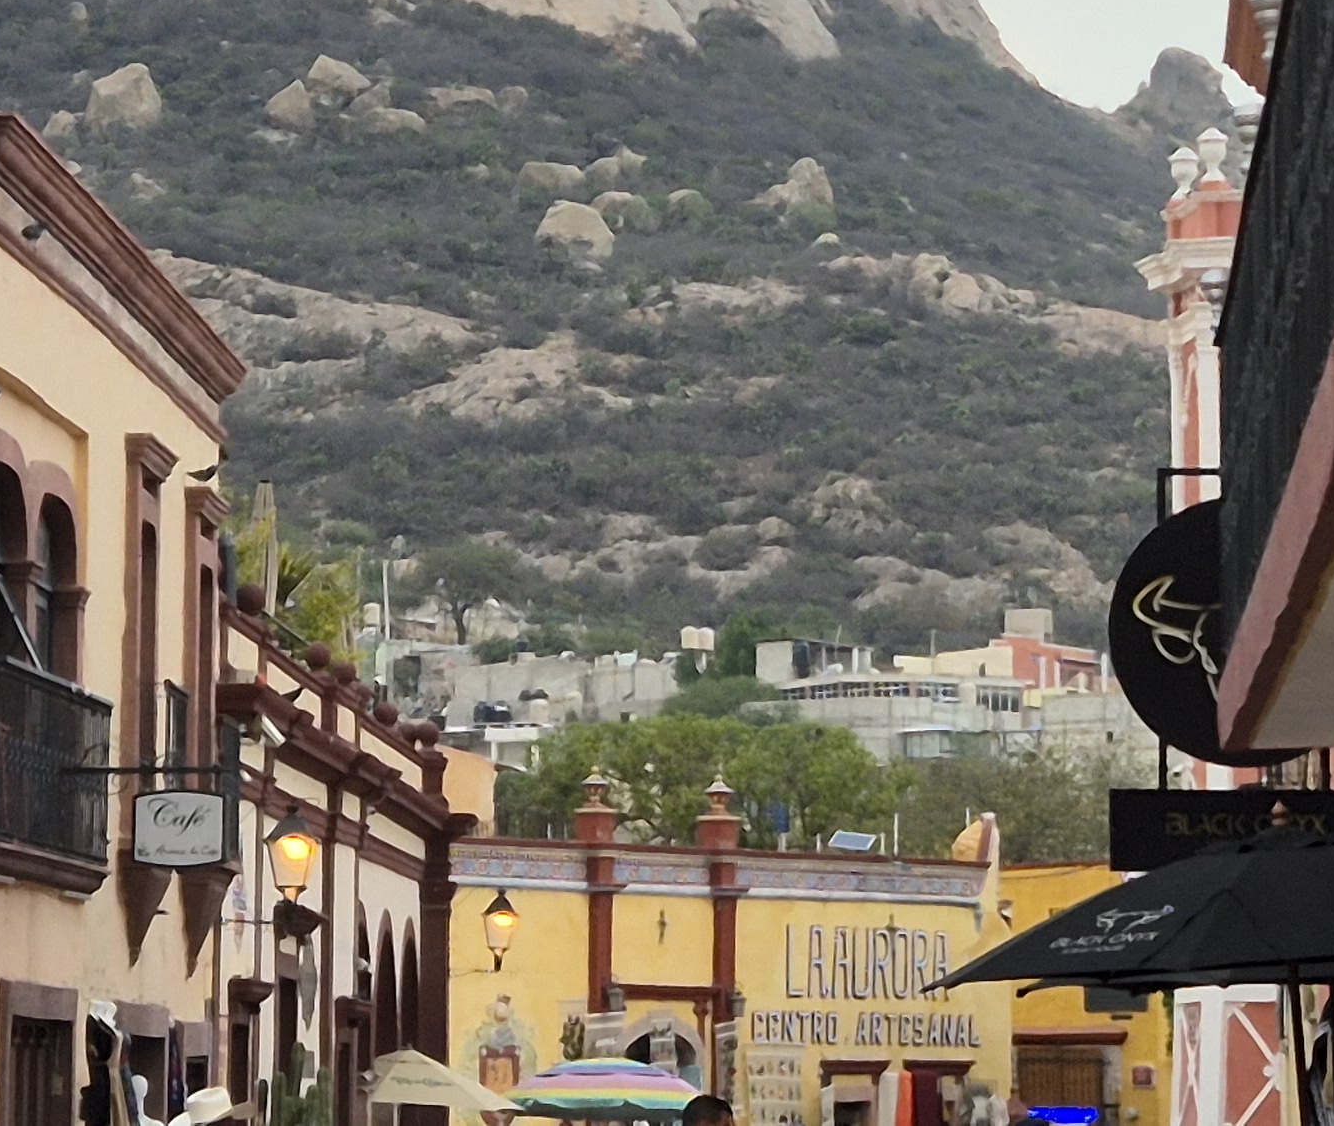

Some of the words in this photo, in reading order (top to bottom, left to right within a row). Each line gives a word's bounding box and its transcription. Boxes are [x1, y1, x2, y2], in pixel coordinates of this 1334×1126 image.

[147, 796, 212, 837] Café
[1164, 811, 1247, 837] BLACK
[1253, 812, 1329, 836] OYX
[751, 1010, 839, 1045] CENTRO
[855, 1011, 982, 1048] ARTESANAL
